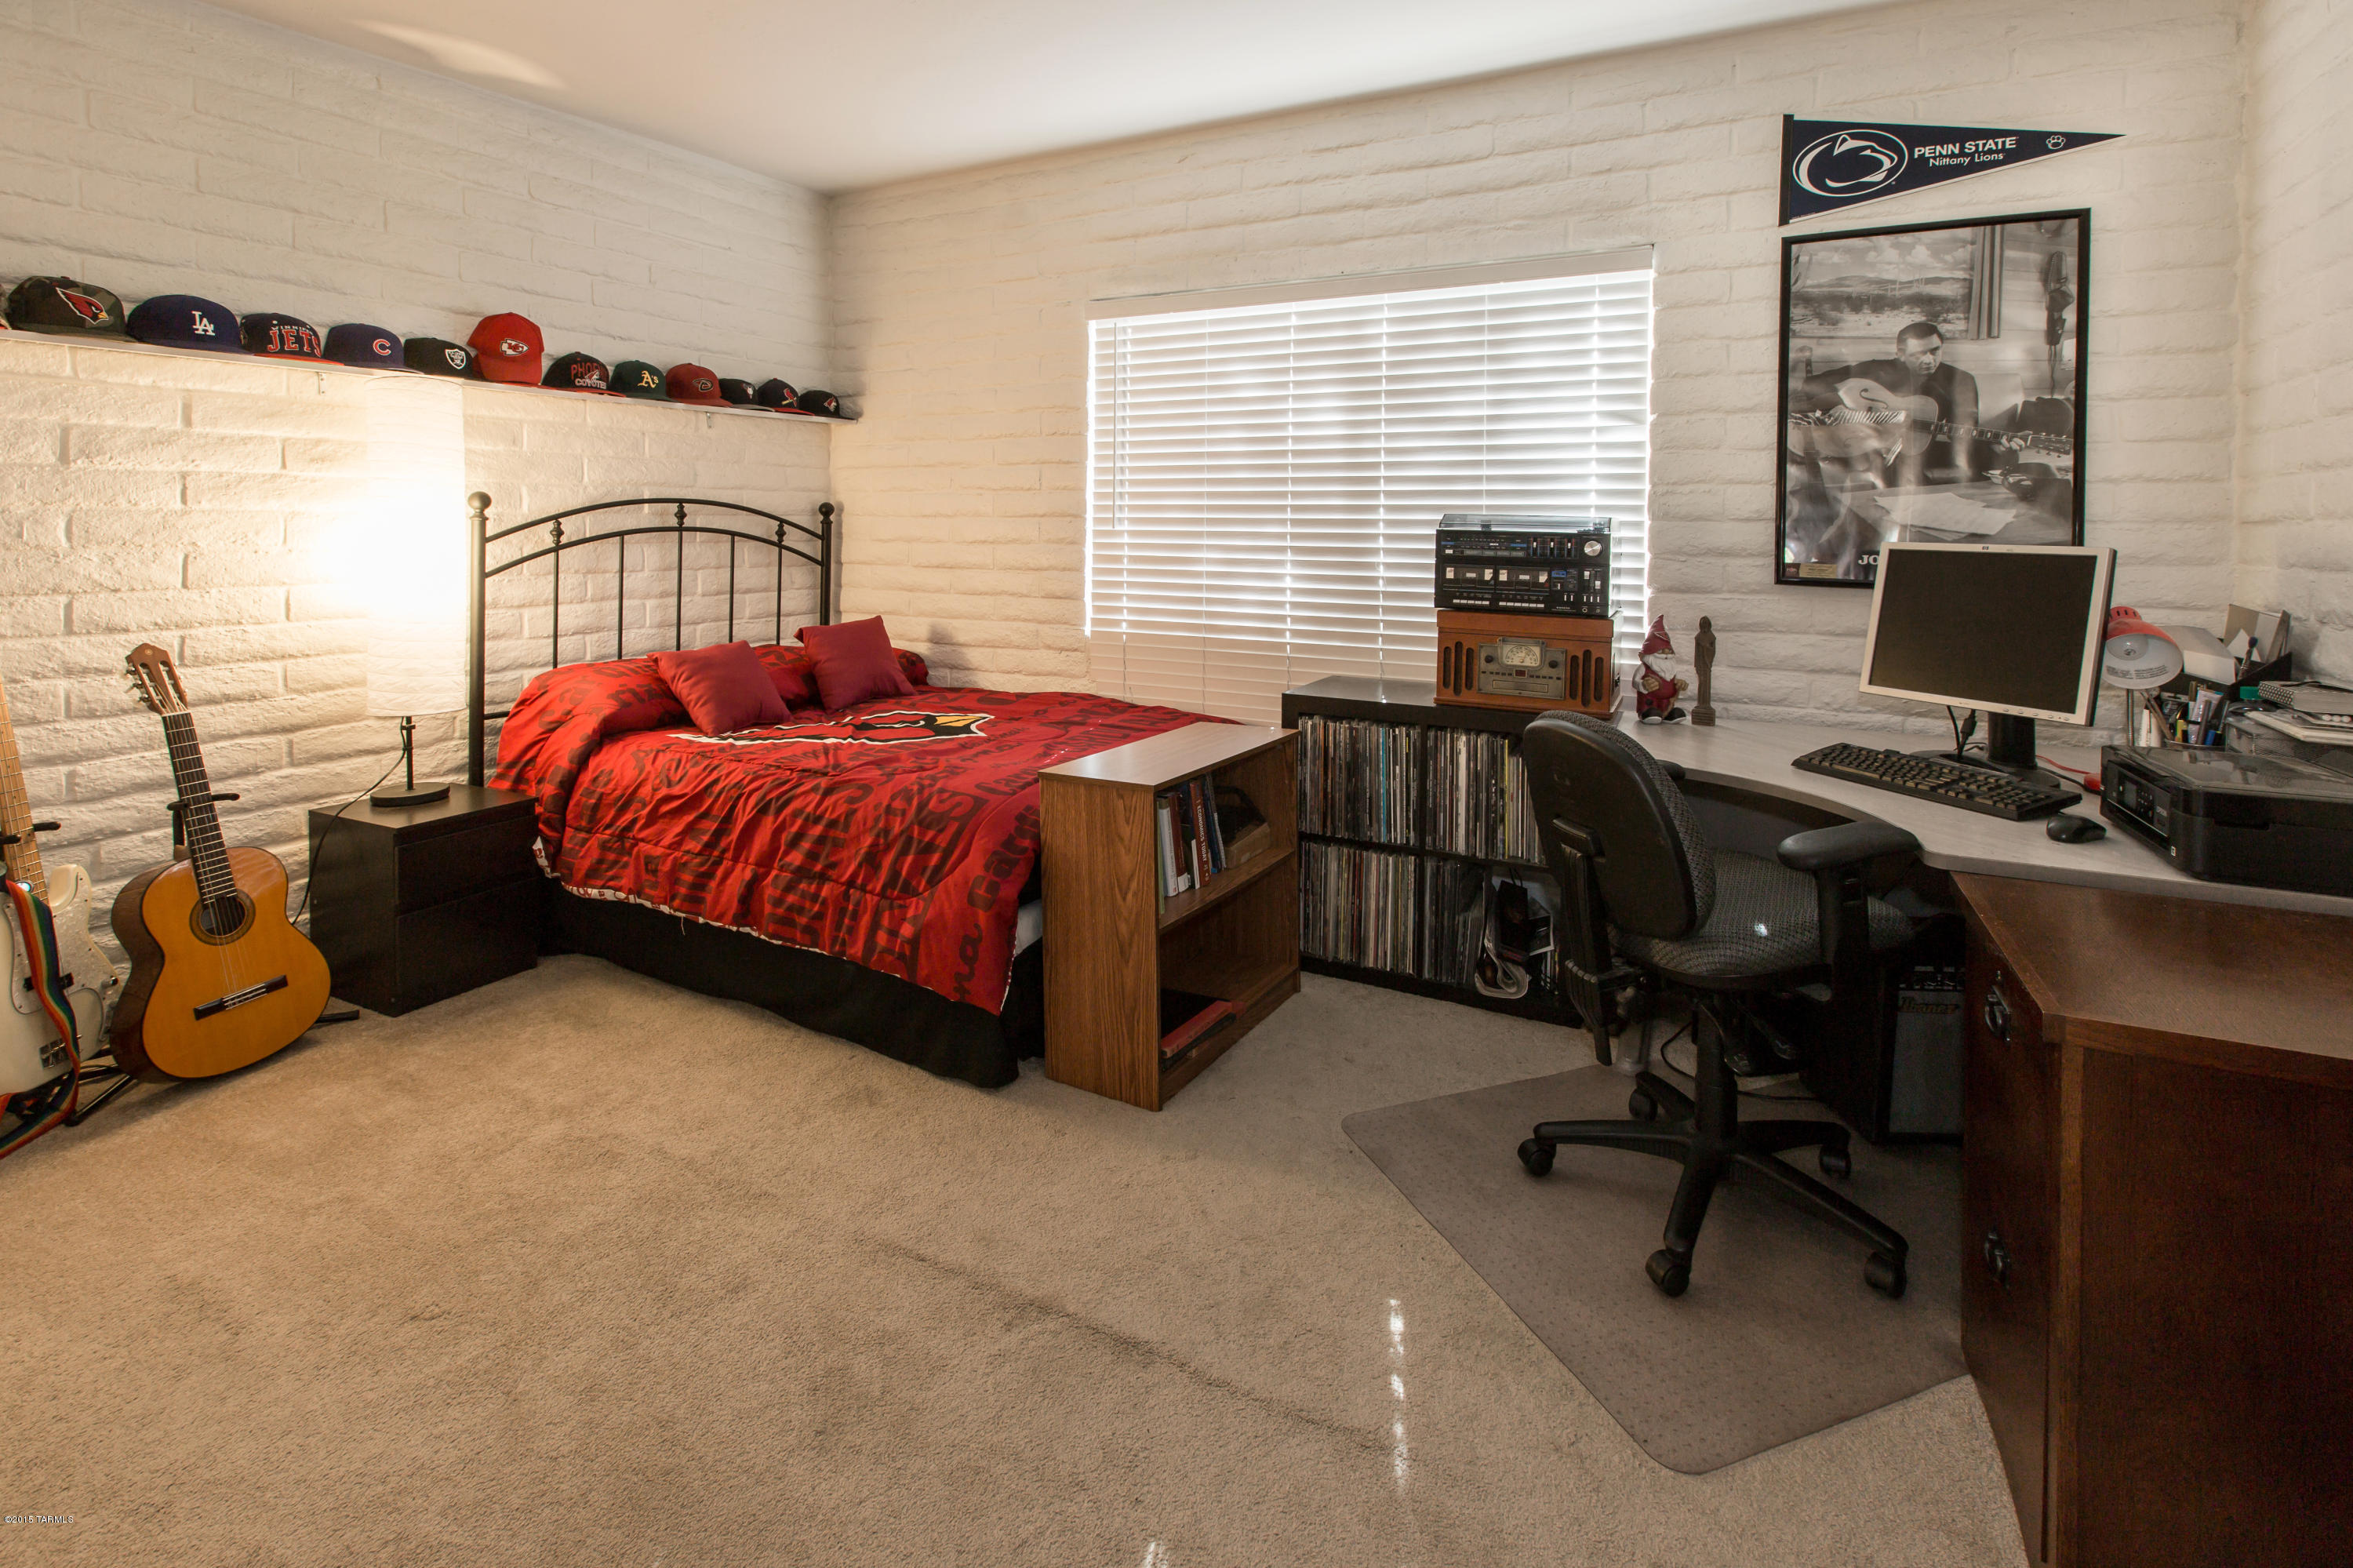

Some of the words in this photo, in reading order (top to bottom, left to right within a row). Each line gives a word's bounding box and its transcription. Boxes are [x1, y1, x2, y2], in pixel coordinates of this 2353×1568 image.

[1914, 143, 1960, 158] PENN
[1964, 136, 2017, 153] STATE
[1929, 156, 1971, 167] Nittany
[1974, 153, 2004, 162] Lions
[191, 311, 216, 336] LA
[267, 329, 322, 358] JETS
